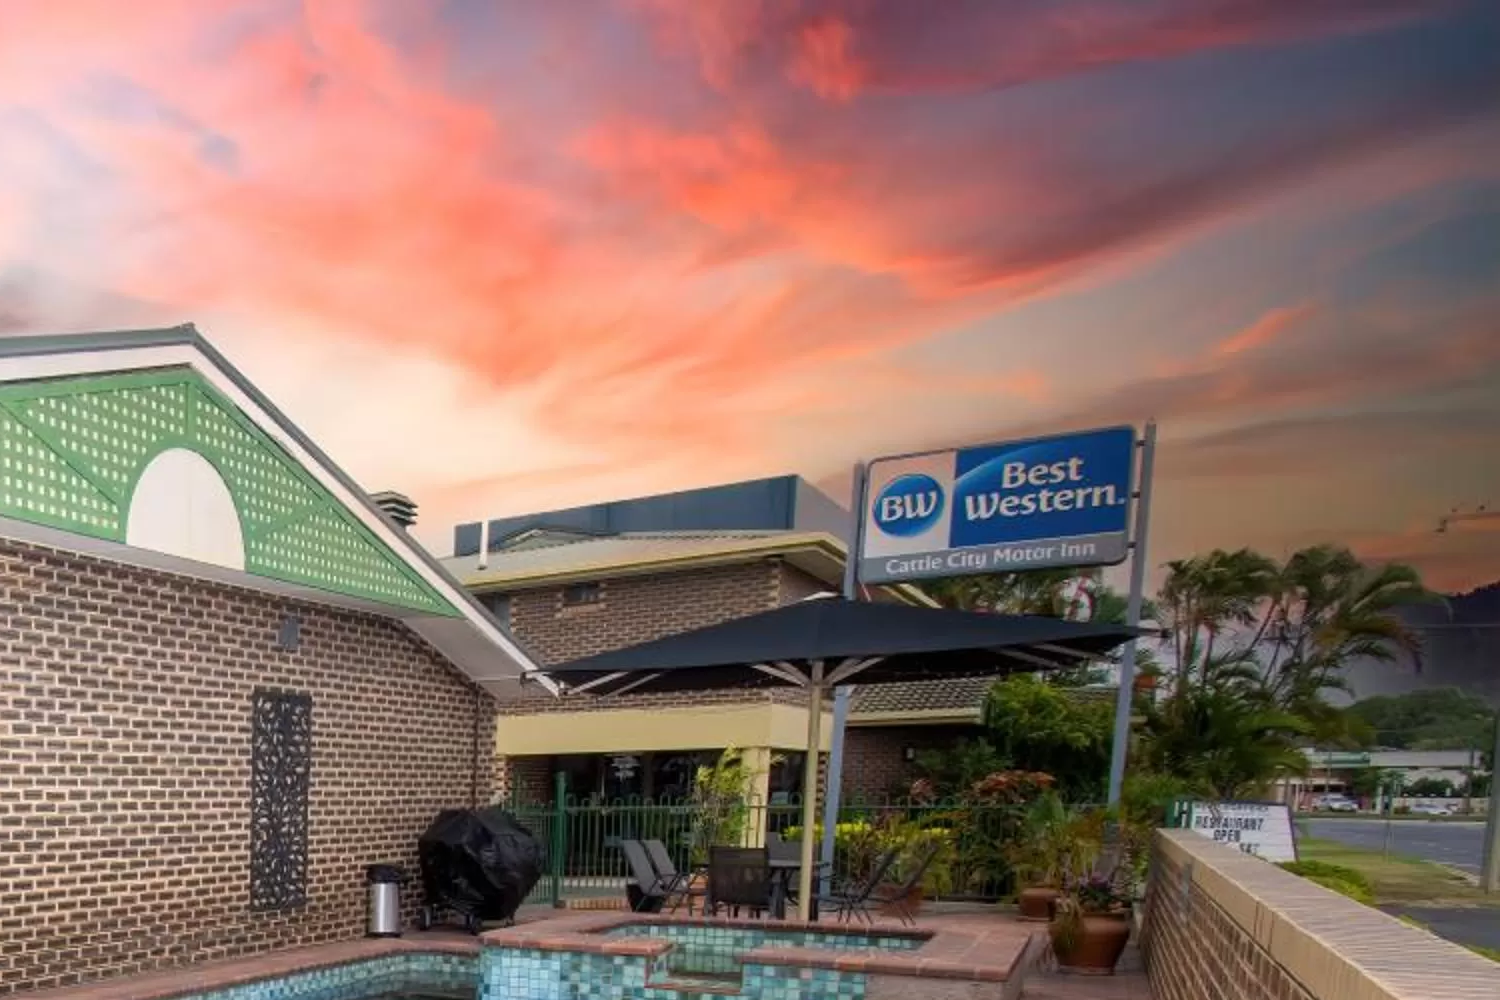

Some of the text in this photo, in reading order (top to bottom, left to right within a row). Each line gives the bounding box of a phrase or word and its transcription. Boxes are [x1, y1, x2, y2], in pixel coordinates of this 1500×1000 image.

[1002, 456, 1085, 489] Best
[880, 490, 937, 522] BW
[885, 542, 1096, 575] Cattle City Motor Inn
[1213, 829, 1241, 842] OPEN
